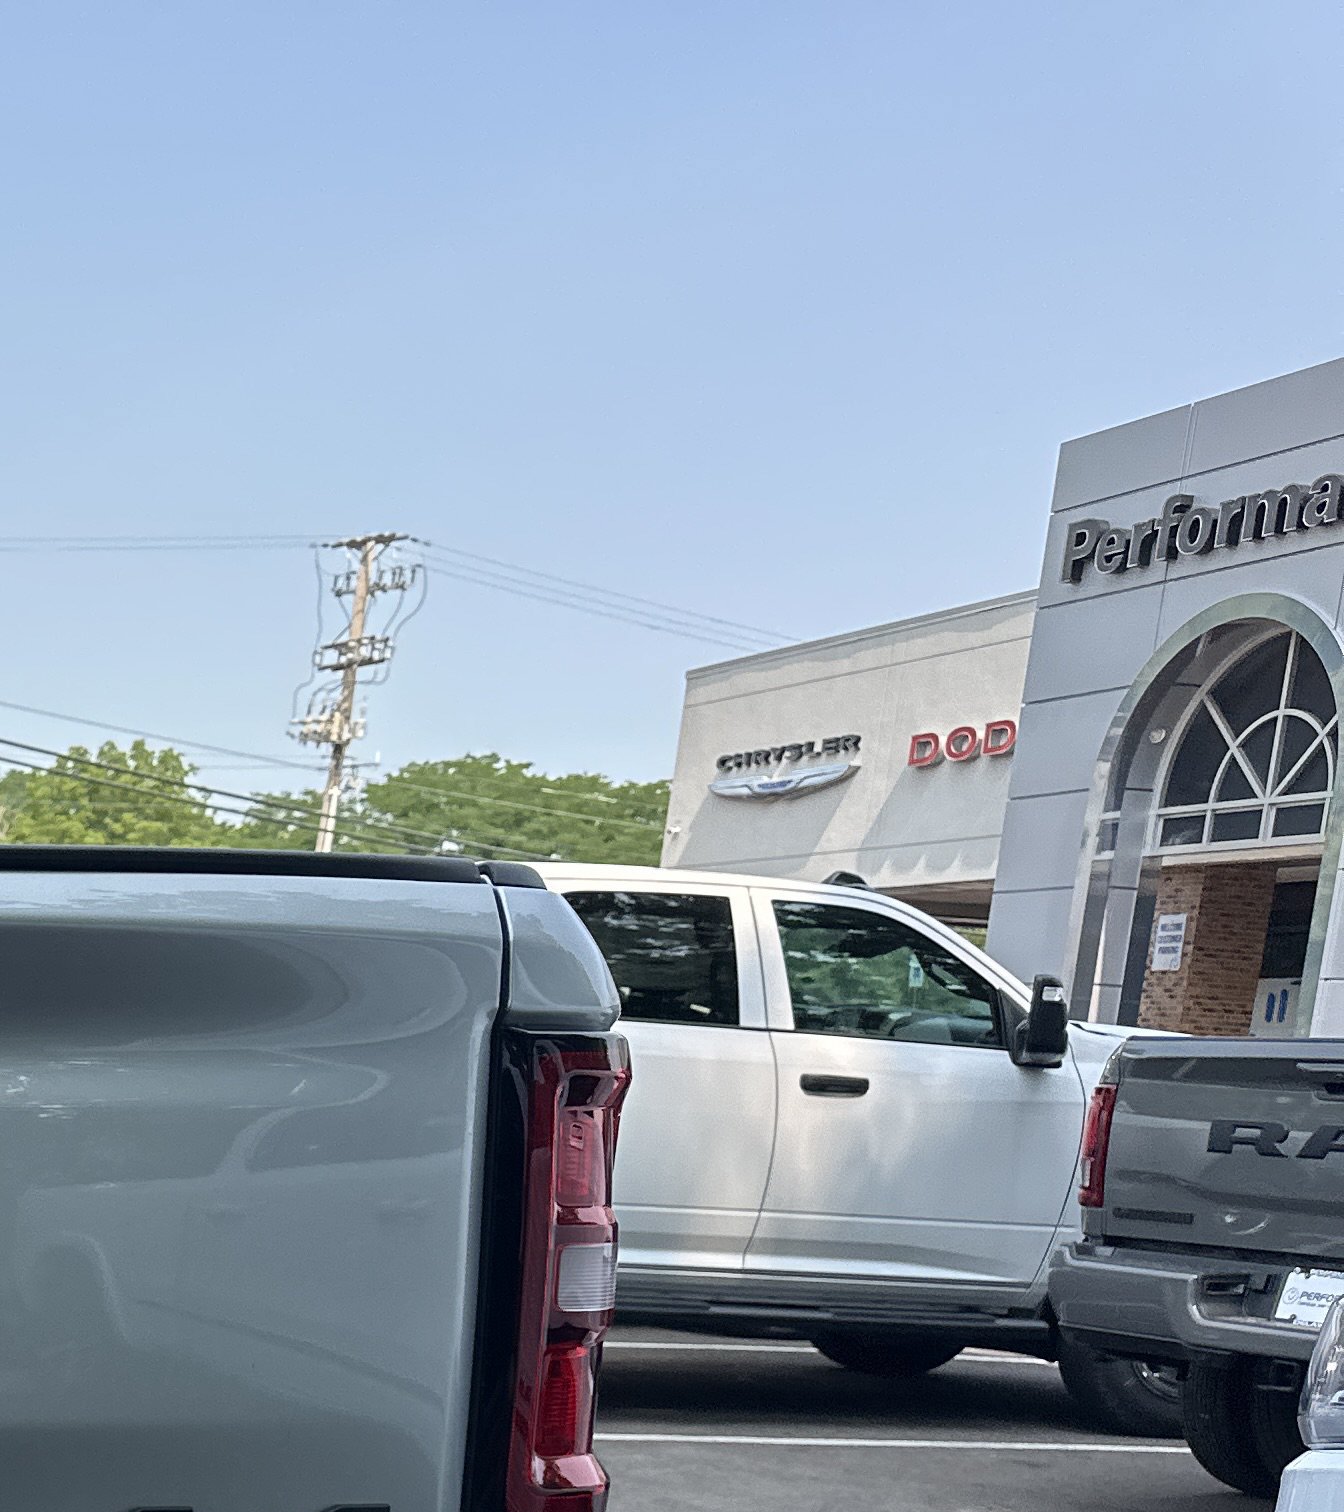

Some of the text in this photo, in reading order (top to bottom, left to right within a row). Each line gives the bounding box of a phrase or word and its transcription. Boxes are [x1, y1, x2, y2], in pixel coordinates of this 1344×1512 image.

[1062, 473, 1344, 584] Performa
[715, 734, 862, 773] CHRYSLER
[908, 719, 1017, 767] DOD
